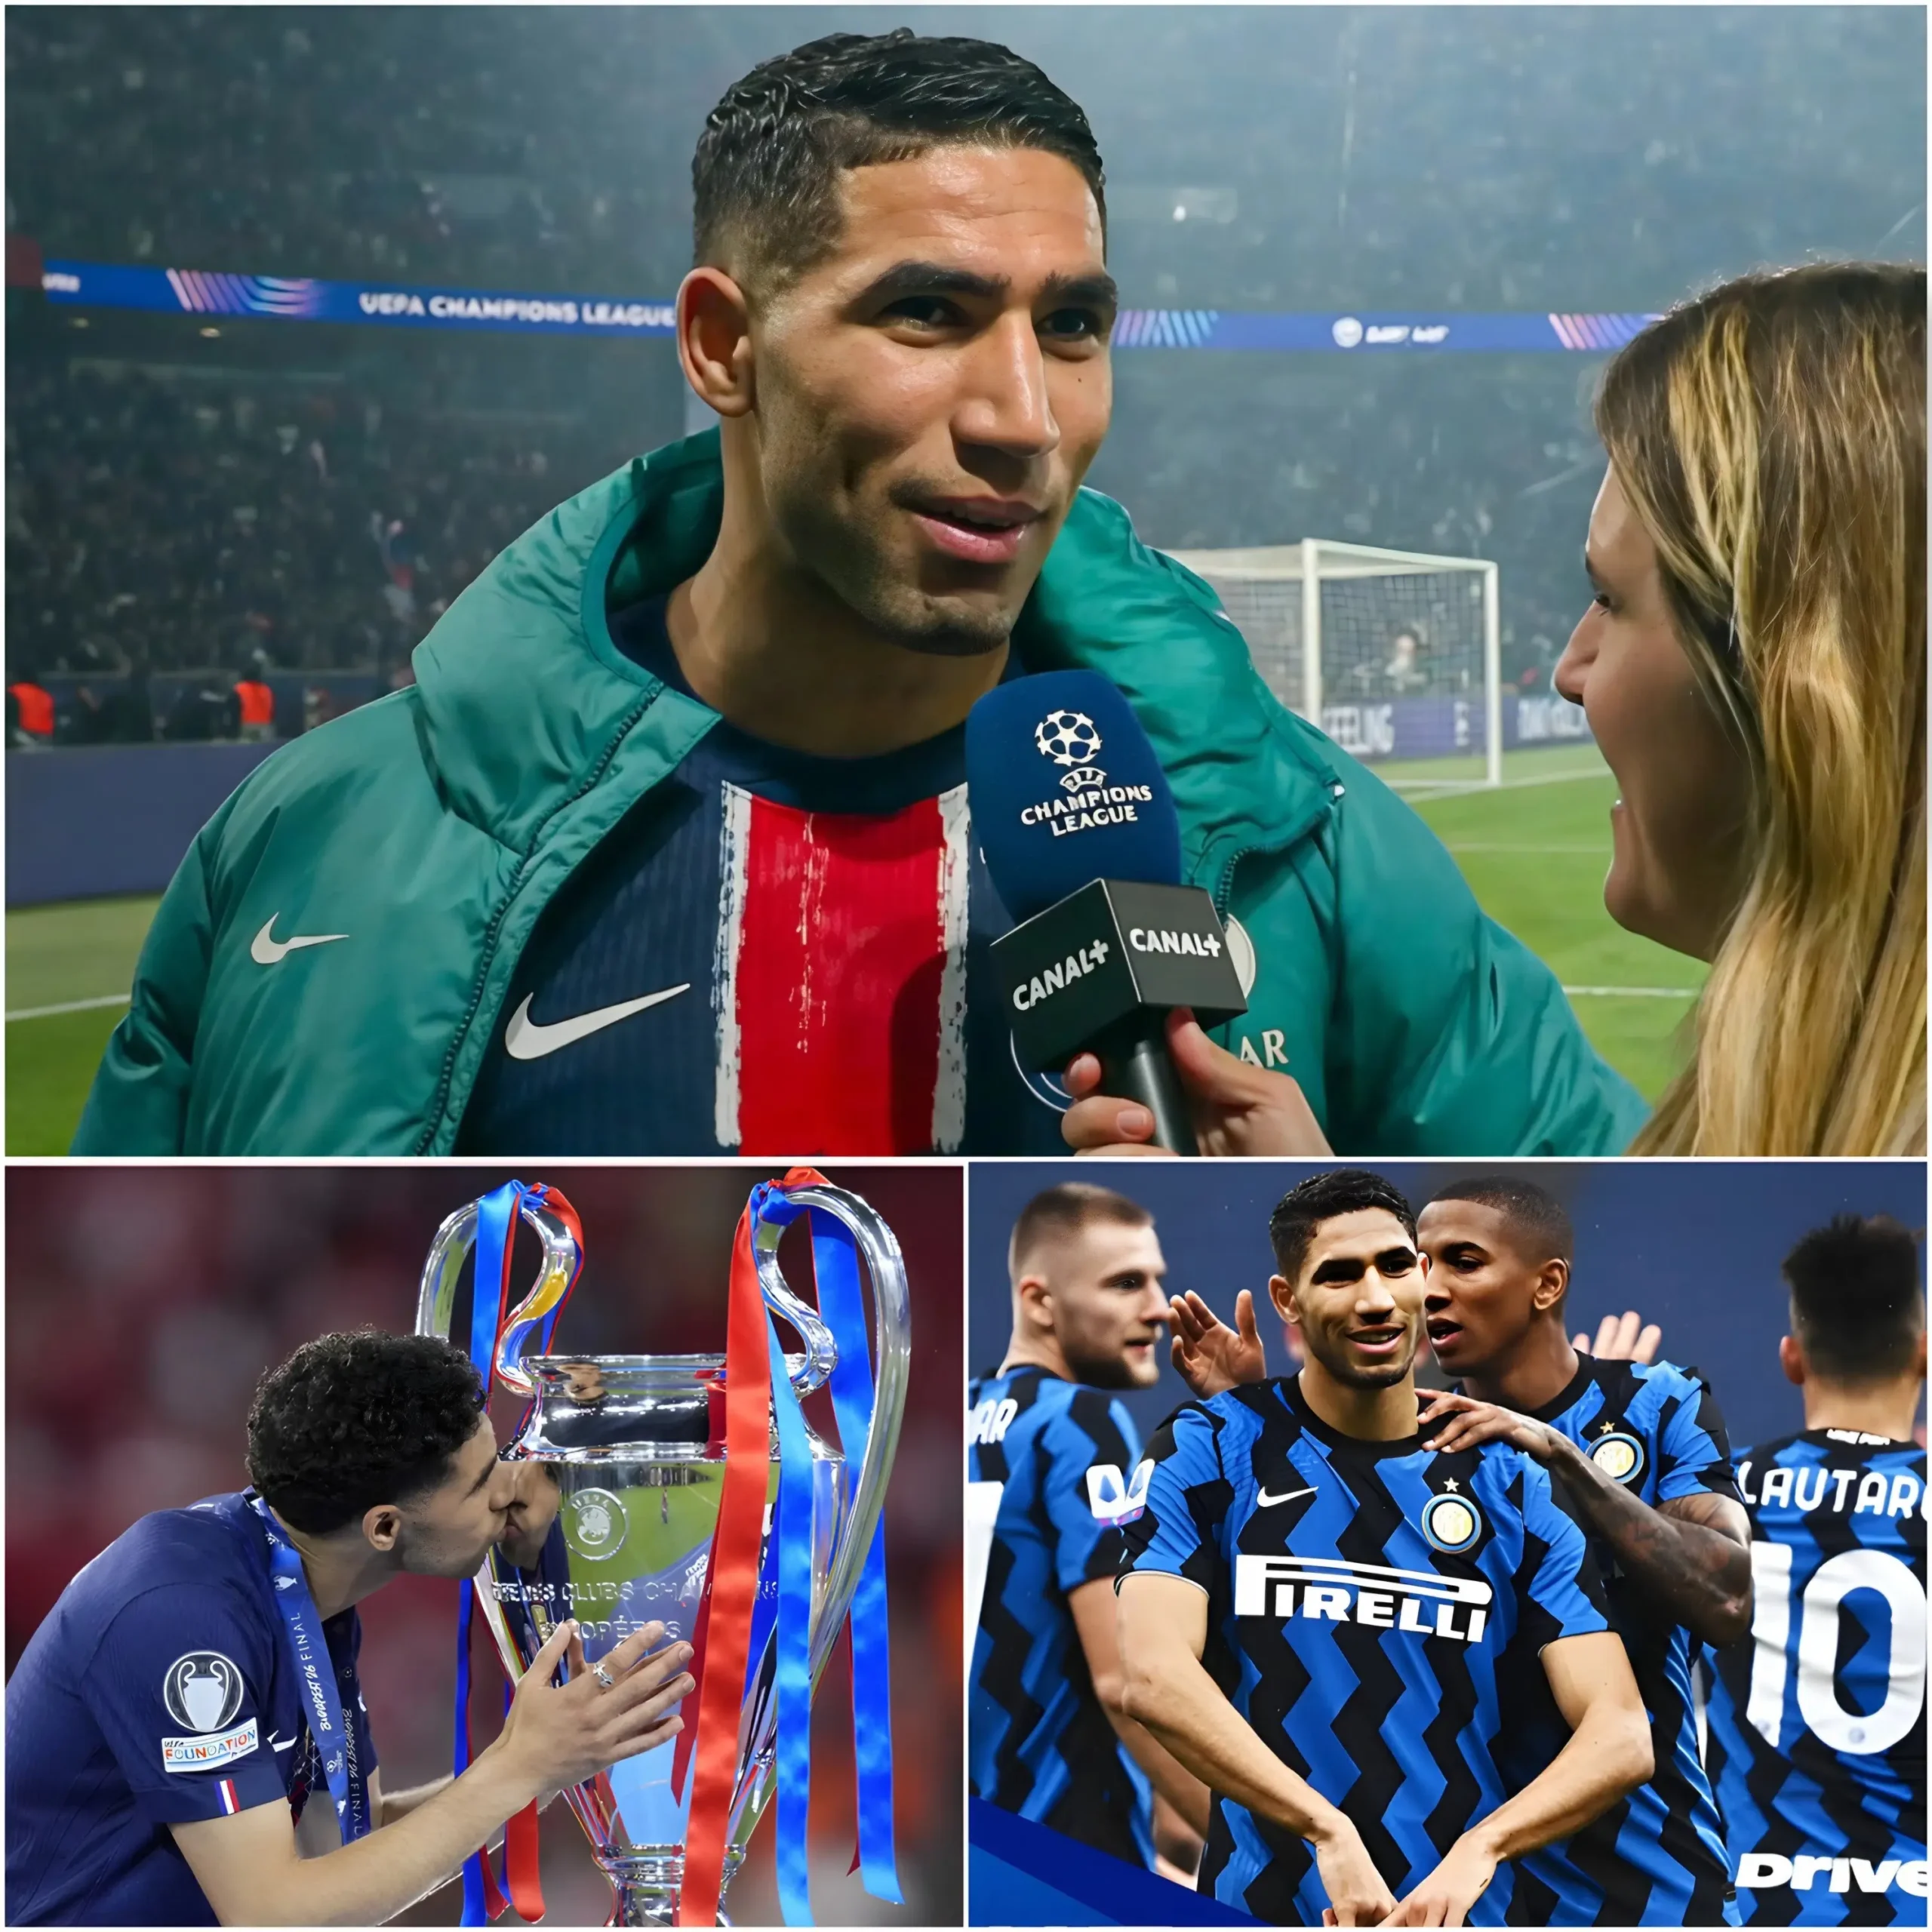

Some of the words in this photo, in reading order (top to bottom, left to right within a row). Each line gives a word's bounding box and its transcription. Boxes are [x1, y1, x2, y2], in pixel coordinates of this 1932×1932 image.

[359, 292, 426, 317] UEFA
[429, 295, 578, 324] CHAMPIONS
[582, 303, 677, 328] LEAGUE
[1021, 785, 1152, 825] CHAMPIONS
[1050, 804, 1138, 837] LEAGUE
[1130, 928, 1221, 958] CANAL+
[1013, 938, 1109, 1011] CANAL+
[1737, 1460, 1927, 1522] LAUTAR
[1234, 1554, 1493, 1643] PIRELLI
[291, 1612, 312, 1661] FINAL
[1746, 1540, 1927, 1755] 10
[165, 1729, 256, 1760] FOUNDATION
[350, 1783, 364, 1835] FINAL
